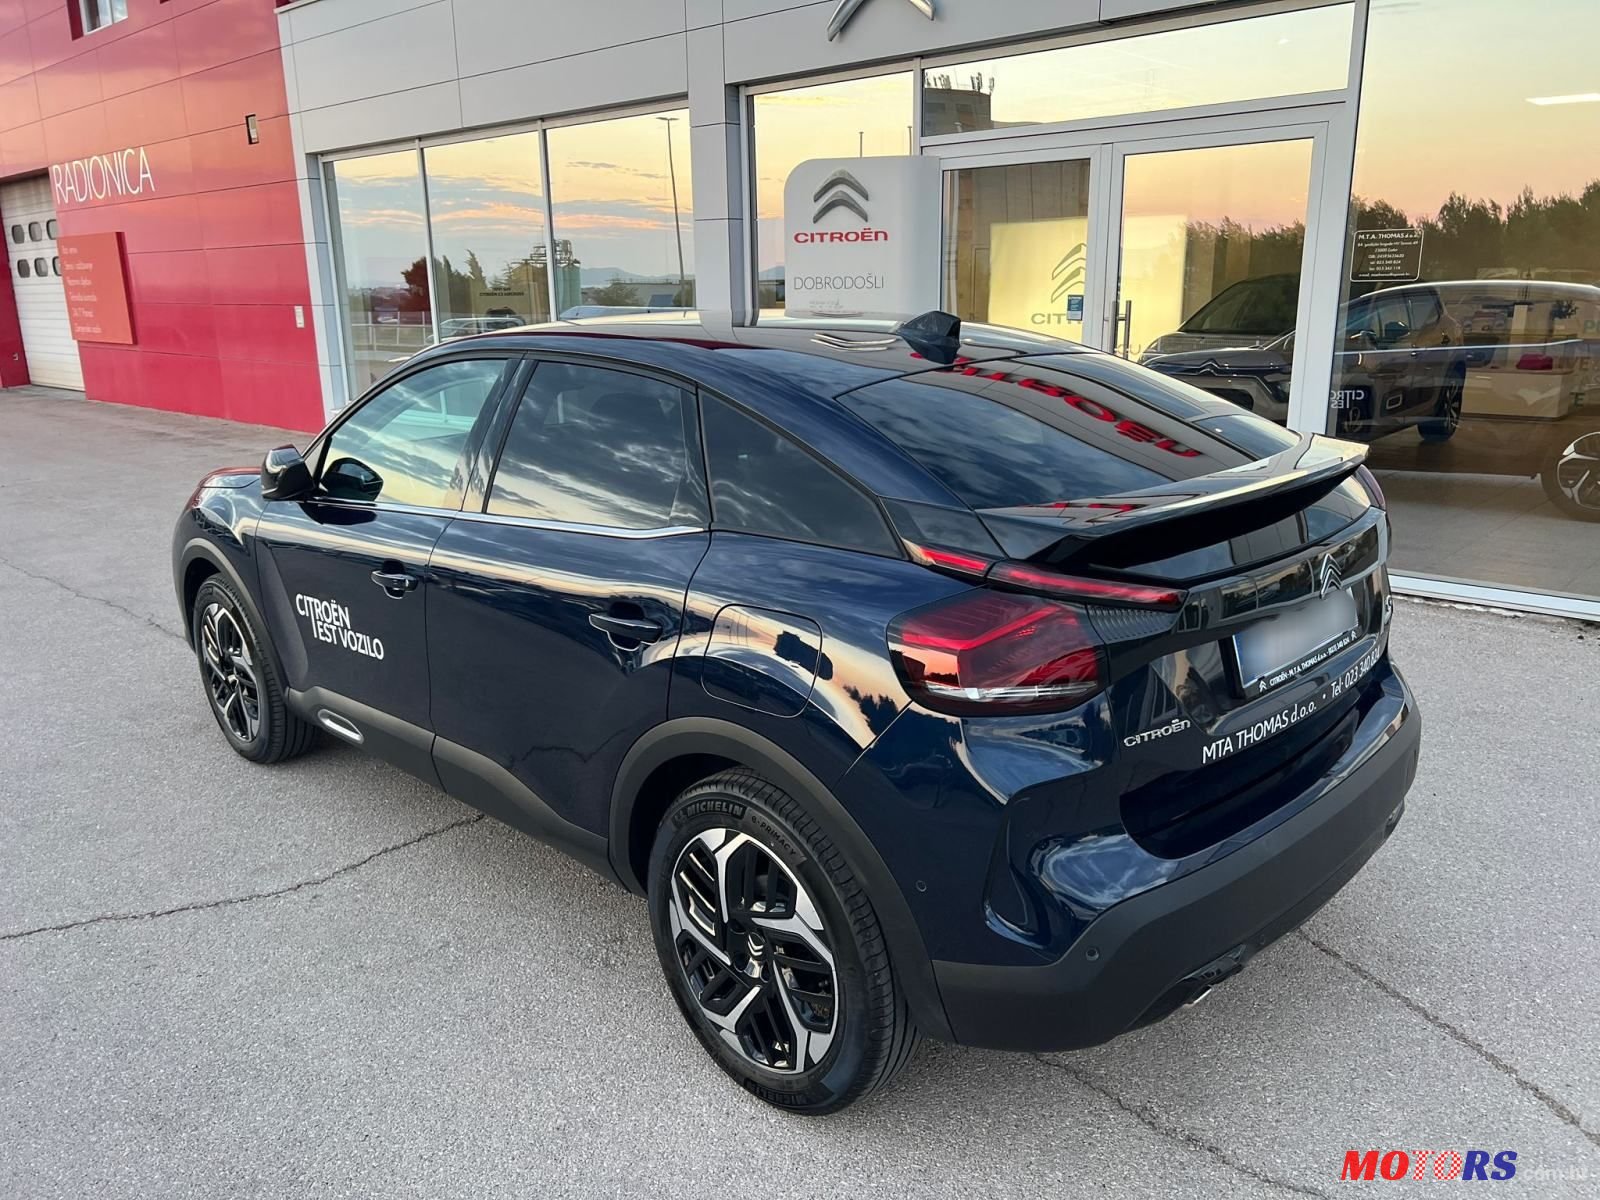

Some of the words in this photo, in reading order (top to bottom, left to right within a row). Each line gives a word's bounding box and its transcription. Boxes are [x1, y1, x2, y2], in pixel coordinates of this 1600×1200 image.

[52, 146, 155, 204] RADIONICA
[794, 272, 884, 290] DOBRODOŠLI
[295, 593, 351, 634] CITROËN
[338, 627, 384, 660] VOZILO
[1301, 656, 1318, 670] THOMAS
[1202, 740, 1233, 764] MTA
[1236, 710, 1289, 749] THOMAS
[1290, 704, 1317, 723] d.o.o.
[1344, 665, 1359, 688] 023
[1359, 655, 1371, 678] 340
[1370, 645, 1380, 667] 824
[687, 800, 744, 817] MICHELIN
